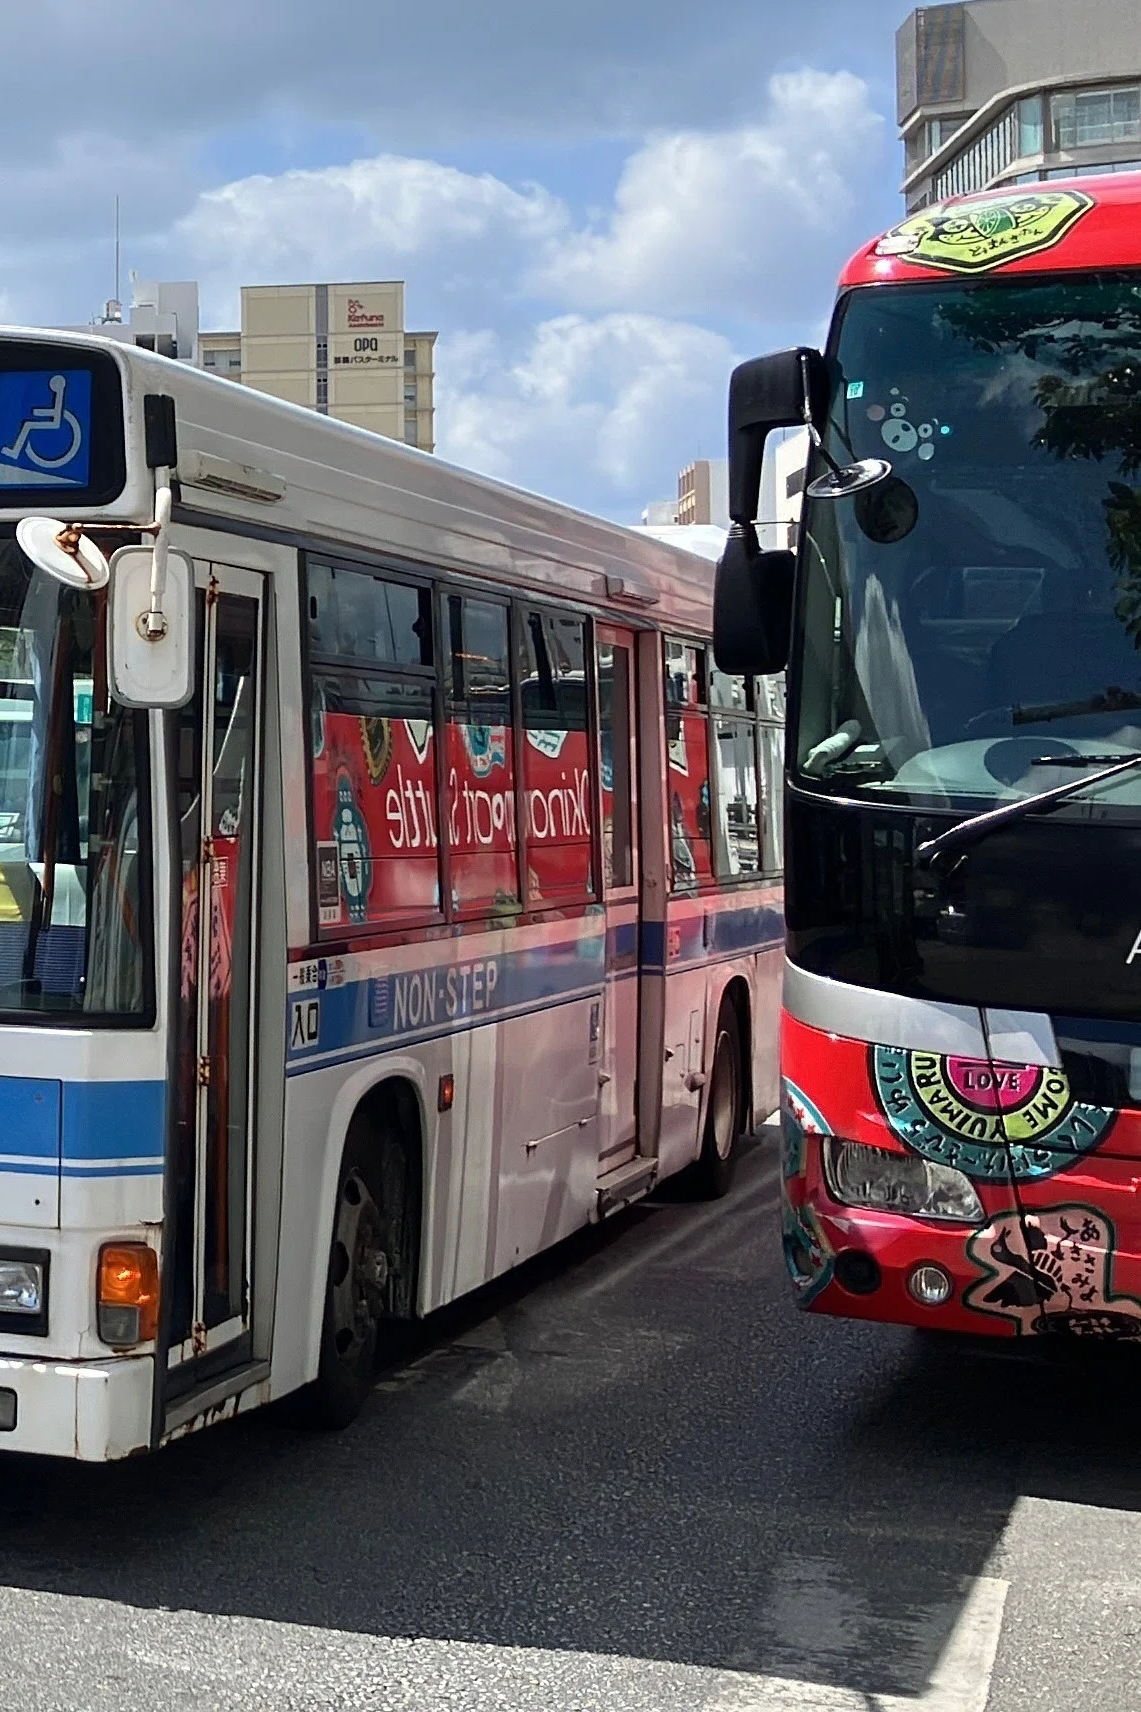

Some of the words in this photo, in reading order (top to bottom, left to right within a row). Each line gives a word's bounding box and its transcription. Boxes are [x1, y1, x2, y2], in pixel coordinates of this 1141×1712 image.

[393, 961, 498, 1031] NON-STEP
[292, 1002, 319, 1047] 入口
[964, 1072, 1021, 1092] LOVE
